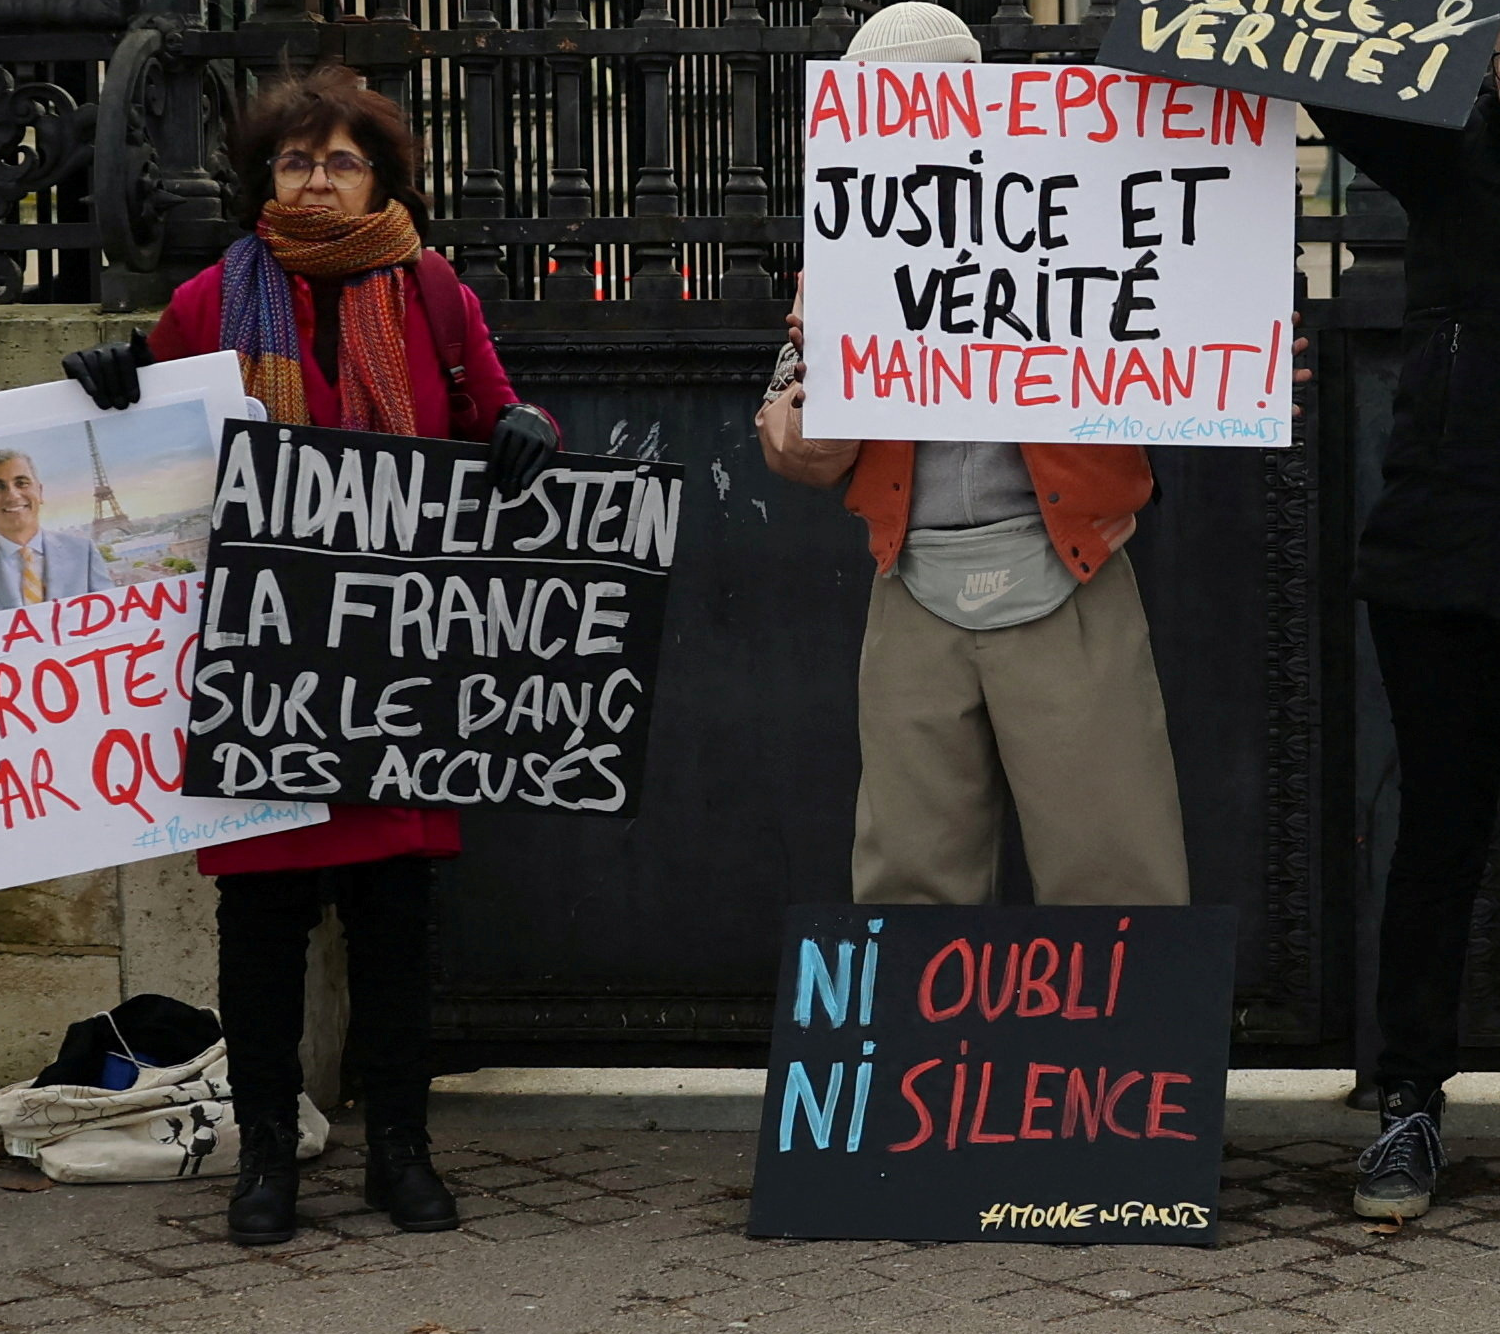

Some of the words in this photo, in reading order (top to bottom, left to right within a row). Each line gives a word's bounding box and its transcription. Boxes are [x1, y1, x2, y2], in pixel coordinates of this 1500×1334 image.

[1121, 165, 1230, 249] ET
[203, 568, 292, 650] LA
[326, 571, 629, 659] FRANCE
[964, 569, 1010, 596] NIKE
[189, 659, 327, 739] SUR
[342, 678, 433, 739] LE
[458, 674, 644, 748] BANC
[90, 727, 189, 824] QU
[213, 742, 340, 796] DES
[370, 727, 626, 812] ACCUSÉS
